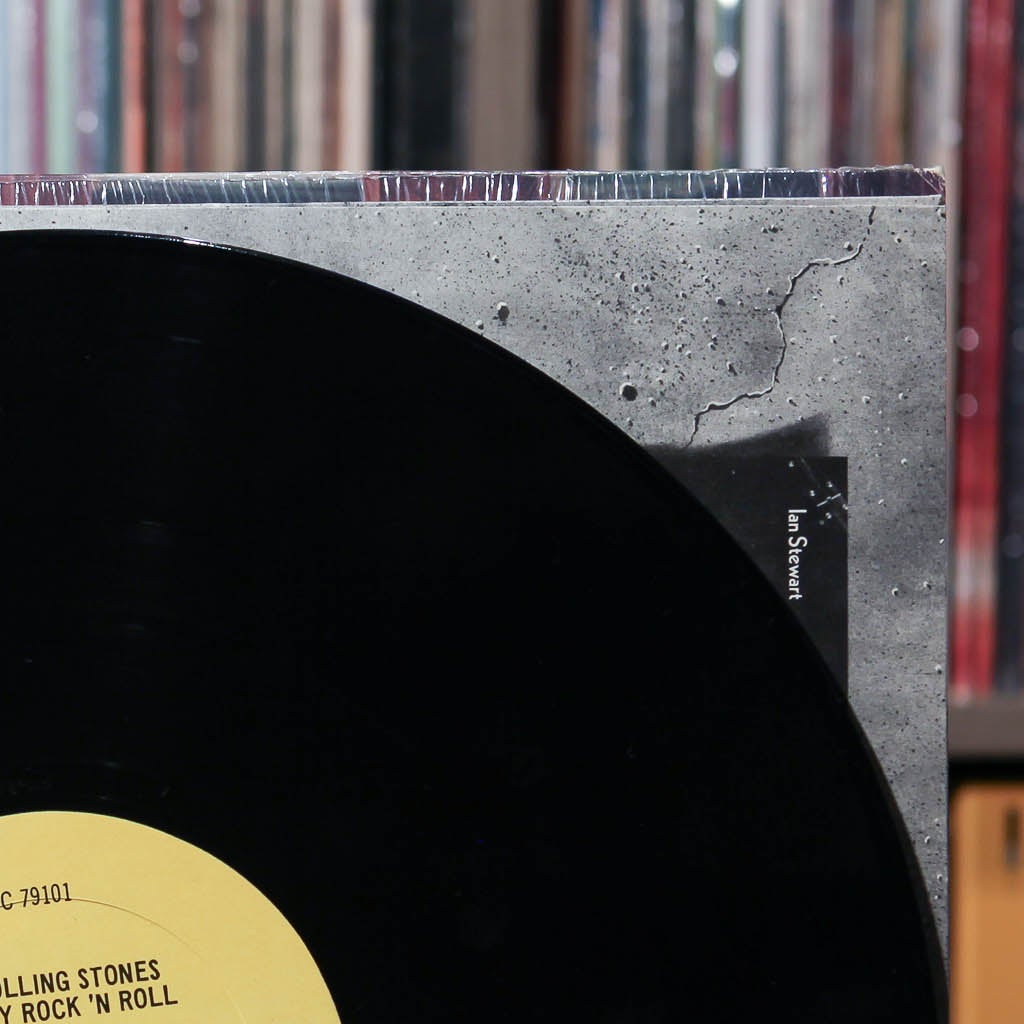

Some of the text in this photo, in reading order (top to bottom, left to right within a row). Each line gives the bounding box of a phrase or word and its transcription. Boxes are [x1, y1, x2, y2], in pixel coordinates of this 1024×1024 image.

[787, 509, 808, 600] Ian Stewart
[20, 882, 72, 907] 79101
[78, 959, 160, 989] STONES
[22, 996, 81, 1023] ROCK
[89, 994, 110, 1014] 'N
[119, 985, 178, 1011] ROLL
